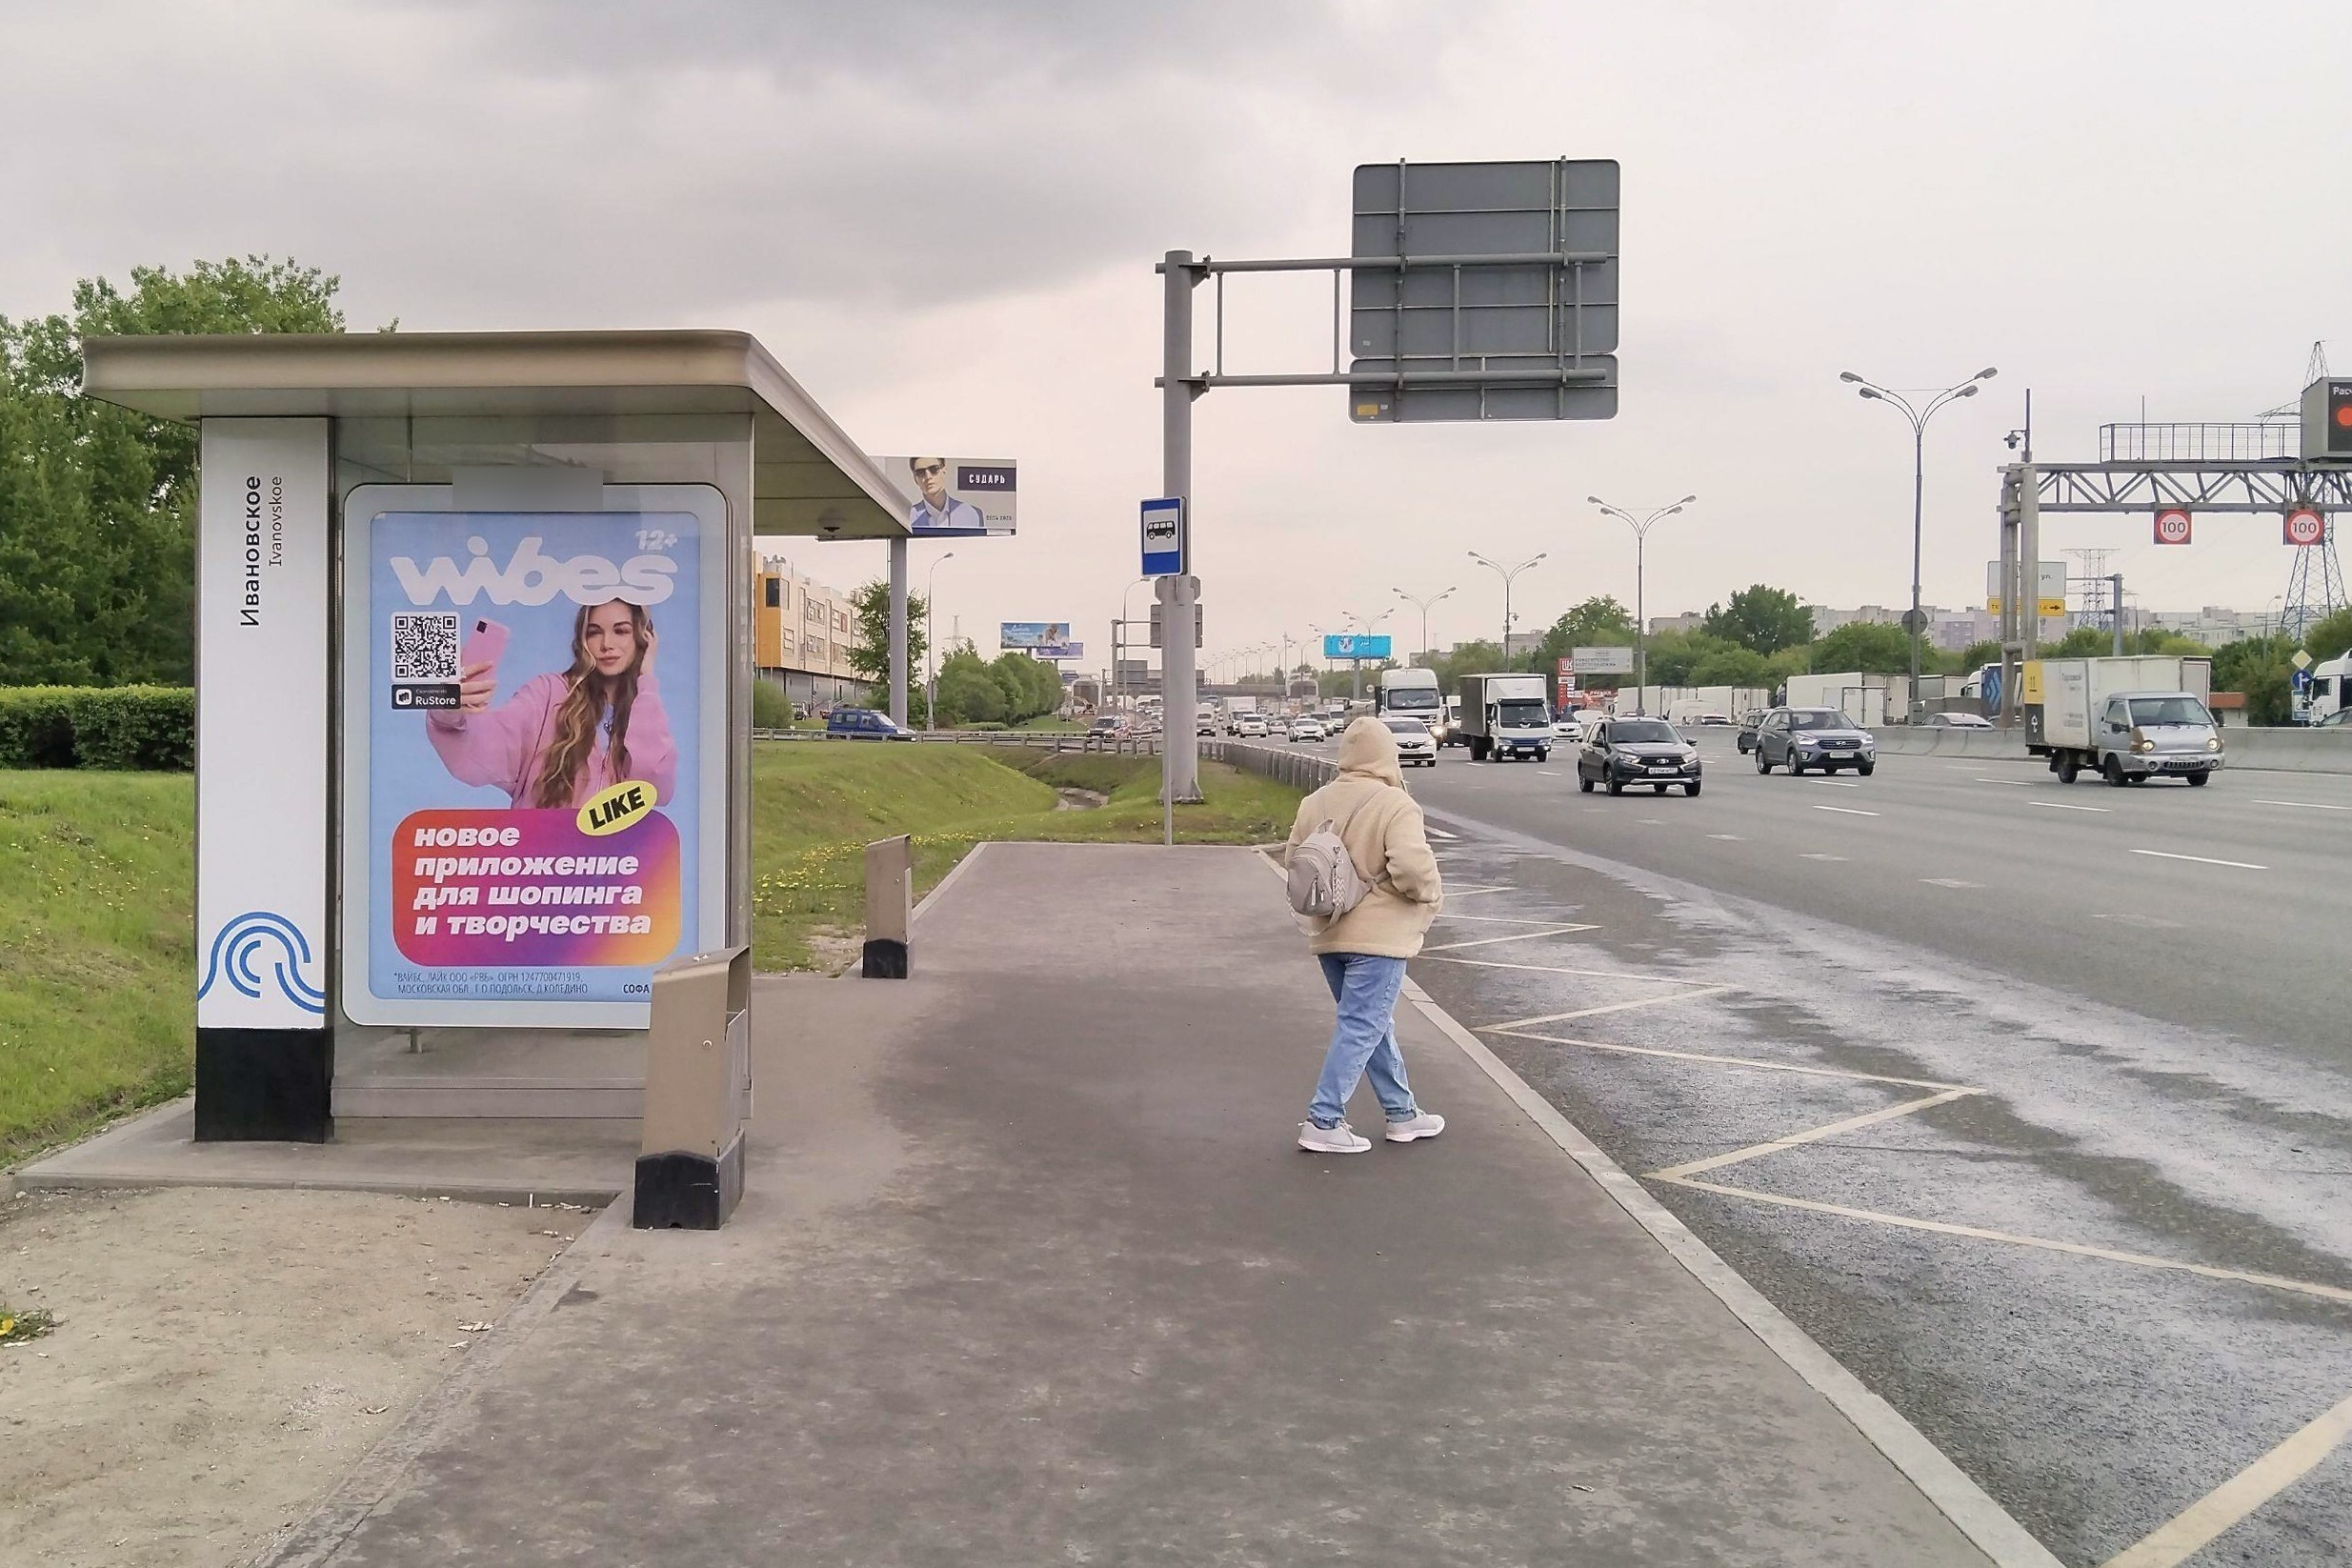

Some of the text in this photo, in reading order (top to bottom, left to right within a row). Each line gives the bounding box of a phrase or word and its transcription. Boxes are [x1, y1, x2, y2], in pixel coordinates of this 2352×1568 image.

[969, 473, 1005, 484] СУДАРЬ
[269, 476, 282, 567] Ivanovskoe
[2162, 522, 2185, 533] 100
[2293, 522, 2317, 533] 100
[635, 530, 677, 550] 12+
[240, 476, 261, 626] Ивановское
[415, 696, 456, 706] RuStore
[589, 786, 646, 830] LIKE
[413, 827, 520, 847] новое
[413, 855, 639, 883] приложение
[412, 885, 643, 911] для шопинга
[414, 915, 652, 942] и творчества
[449, 972, 468, 982] ООО
[497, 972, 519, 982] ОГРН
[398, 984, 451, 994] МОСКОВСКАЯ
[623, 984, 650, 994] СОФА
